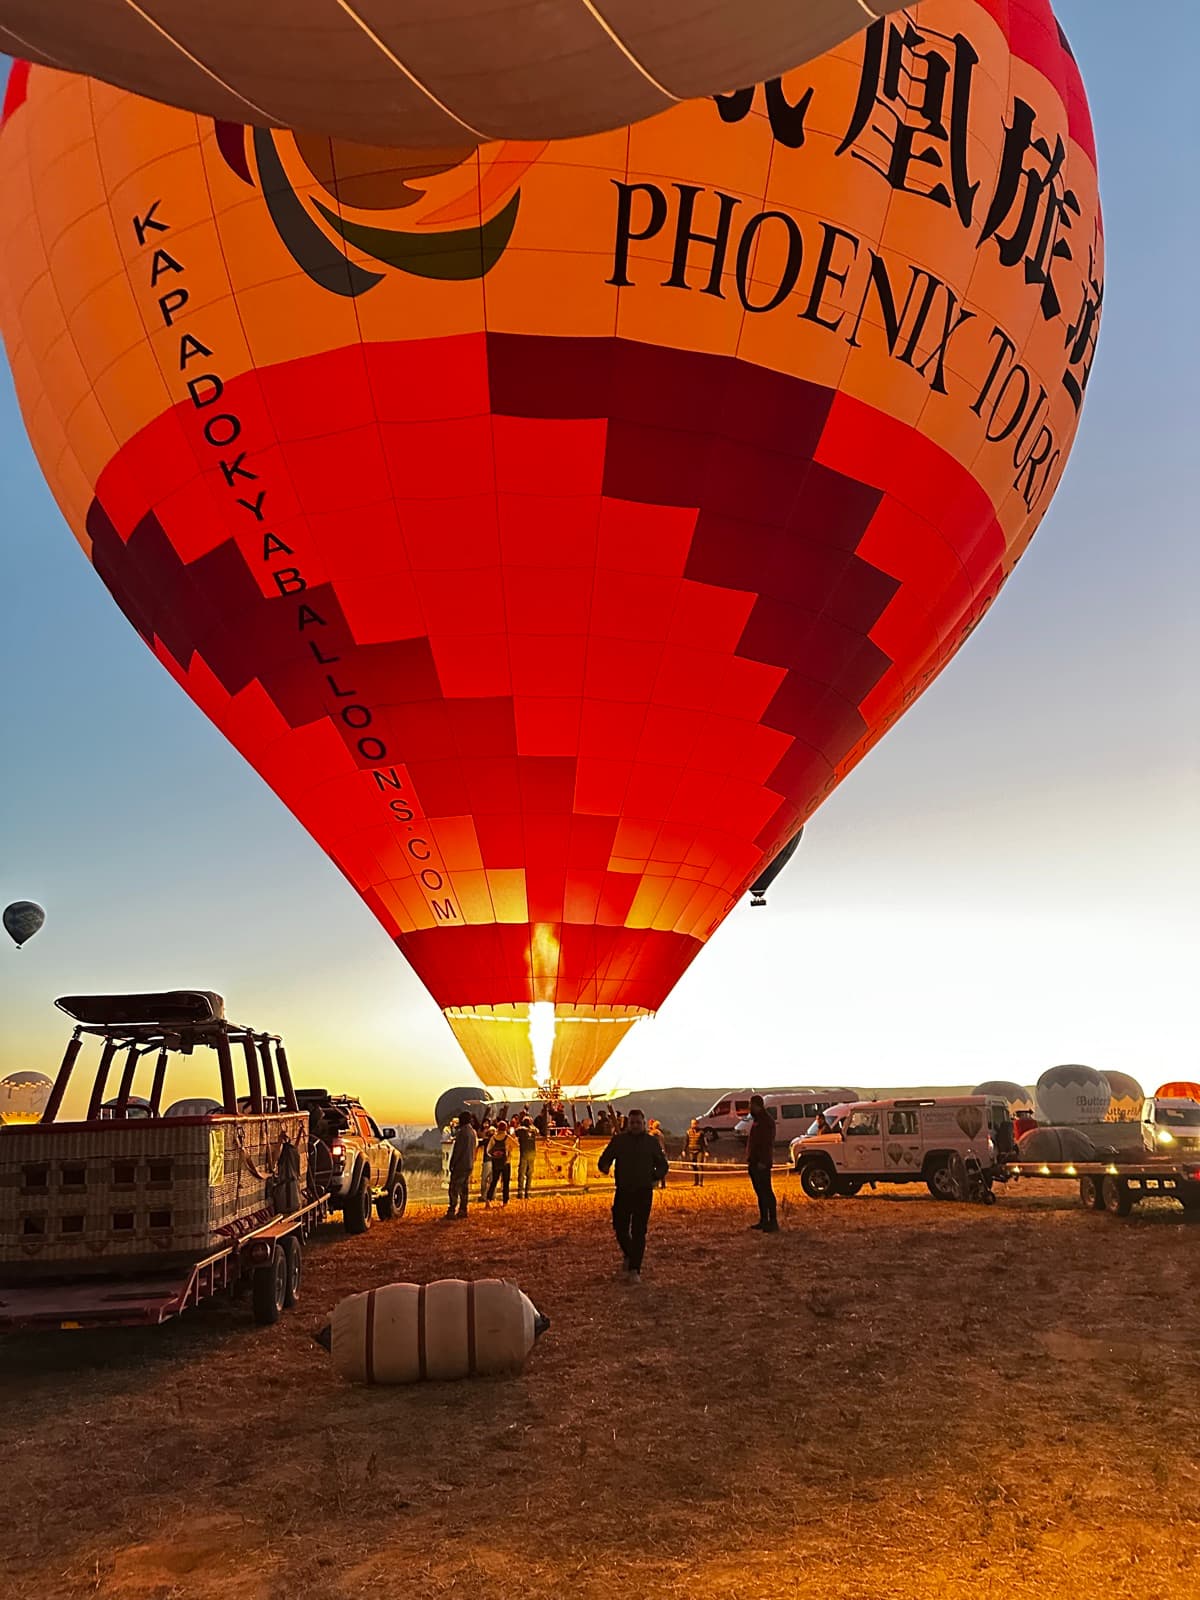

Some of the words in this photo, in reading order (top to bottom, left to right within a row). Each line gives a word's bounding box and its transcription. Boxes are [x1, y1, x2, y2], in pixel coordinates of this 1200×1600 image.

[132, 200, 457, 920] KAPADOKYABALLOONS.COM
[604, 178, 977, 396] PHOENIX
[969, 326, 1061, 514] TOURS
